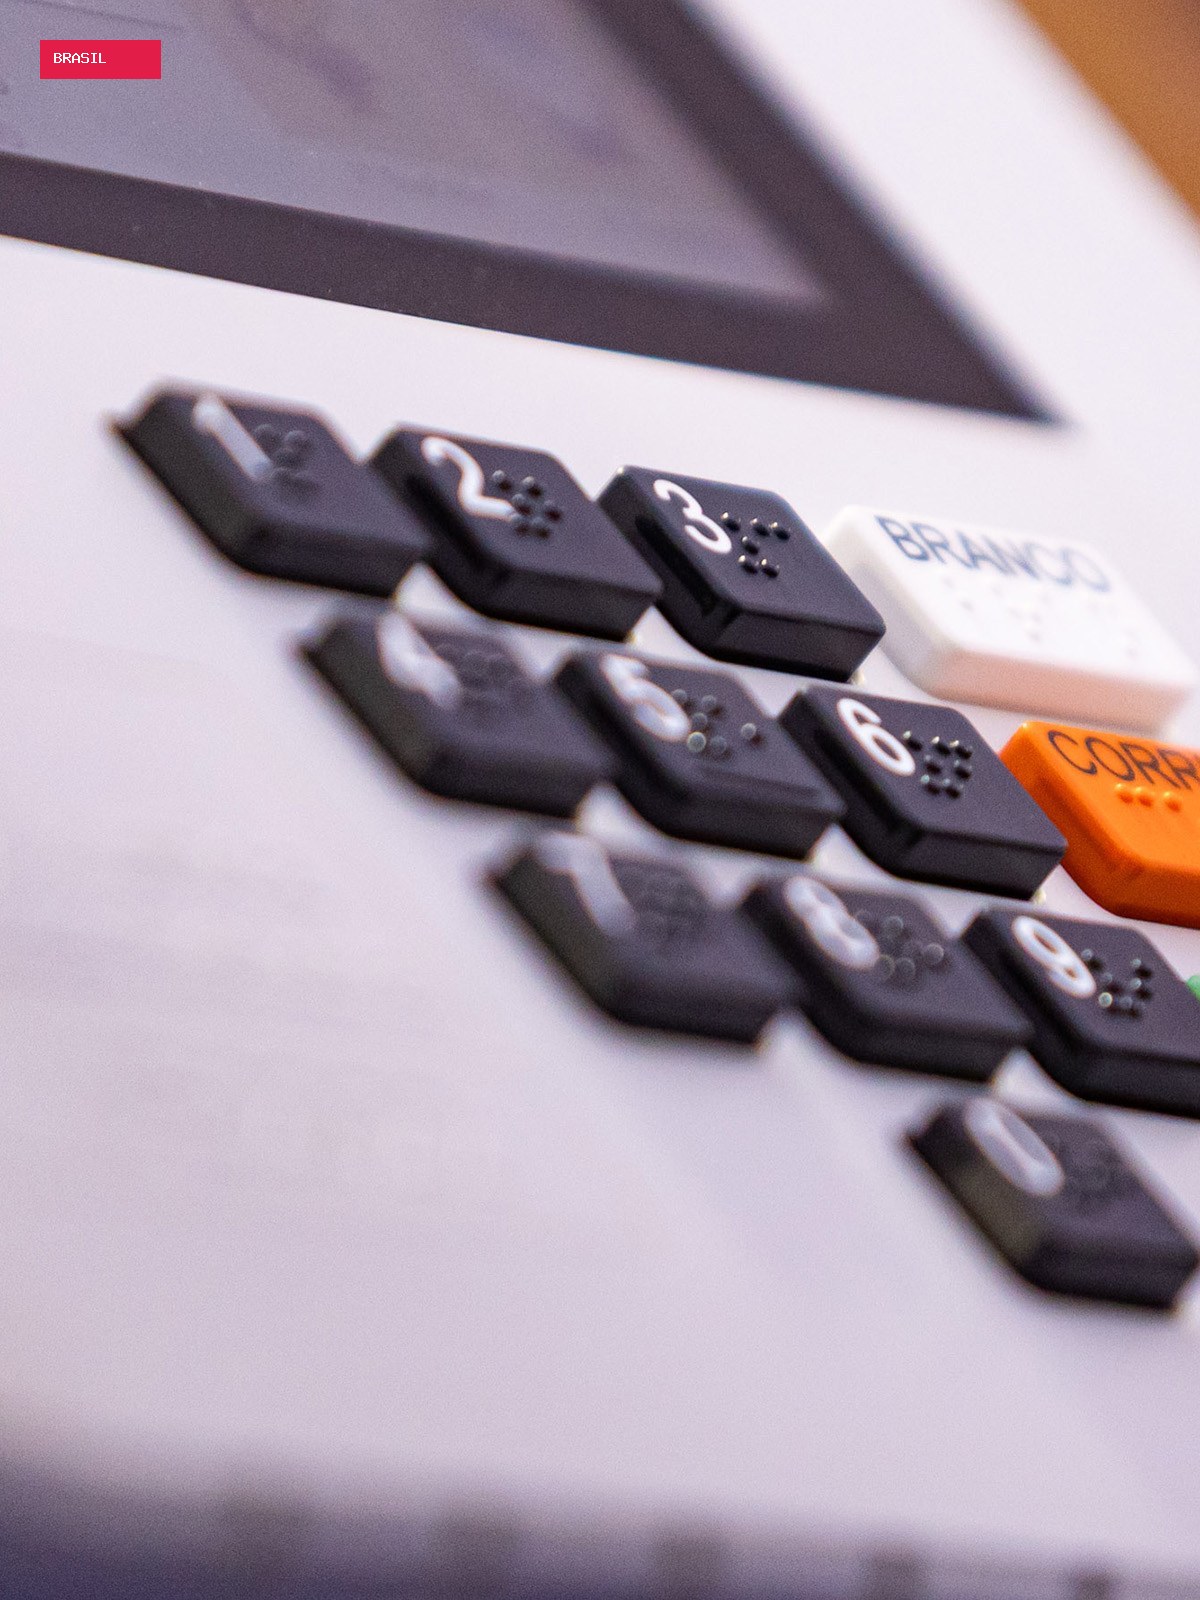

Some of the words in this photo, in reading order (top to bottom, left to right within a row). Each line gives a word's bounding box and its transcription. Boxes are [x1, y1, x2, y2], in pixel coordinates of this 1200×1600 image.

[422, 437, 517, 520] 2
[654, 479, 732, 553] 3
[874, 515, 1111, 592] BRANCO
[602, 653, 690, 743] 5
[837, 698, 915, 776] 6
[786, 876, 879, 970] 8
[1013, 915, 1096, 998] 9
[964, 1099, 1065, 1196] 0
